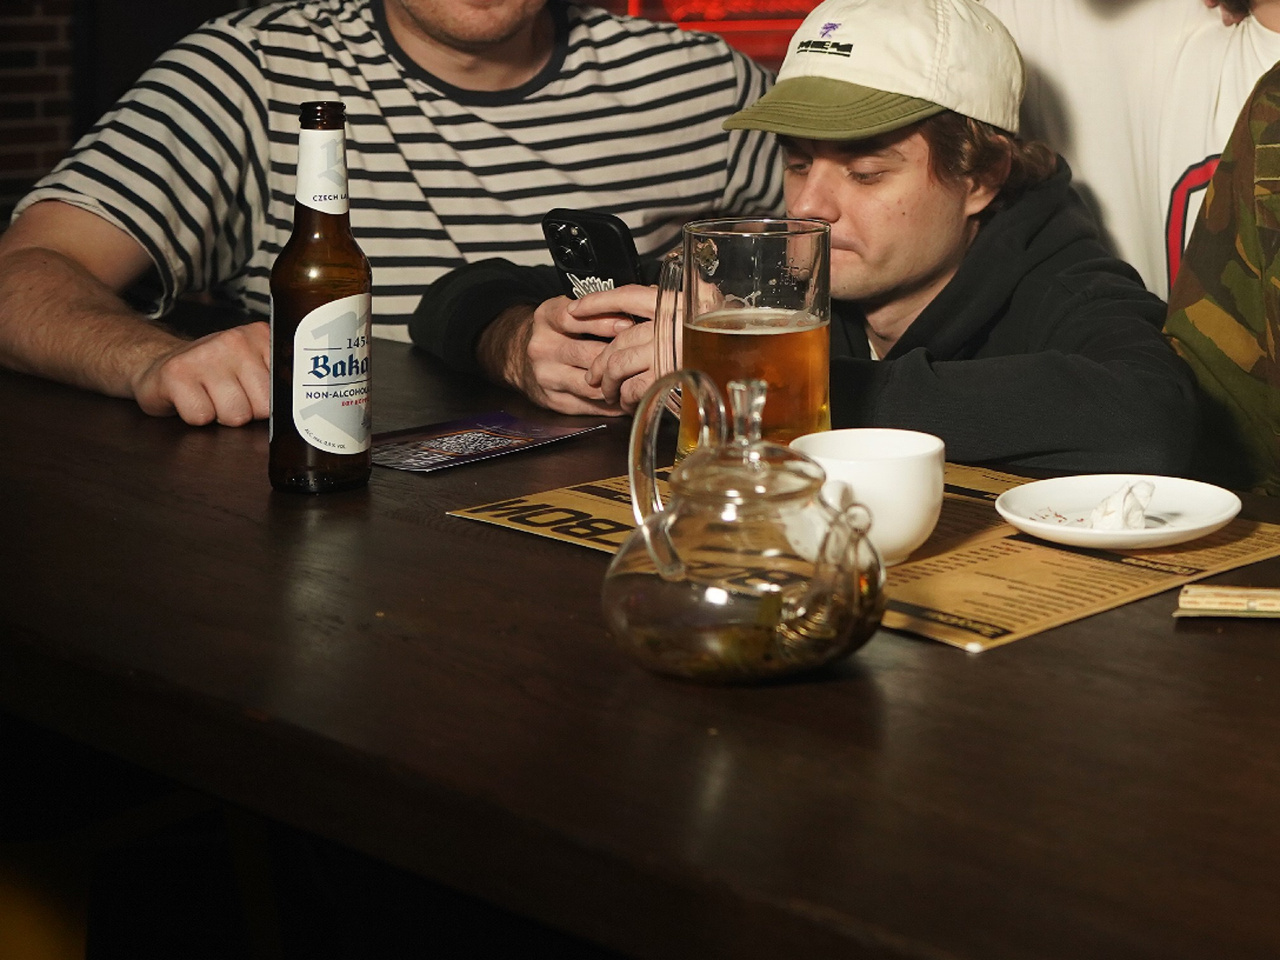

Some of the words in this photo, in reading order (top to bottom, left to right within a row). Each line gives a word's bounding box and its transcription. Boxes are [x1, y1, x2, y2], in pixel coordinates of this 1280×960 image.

[312, 194, 339, 202] CZECH
[346, 335, 369, 349] 145
[308, 354, 369, 379] Baka
[306, 387, 370, 399] NON-ALCOHOL
